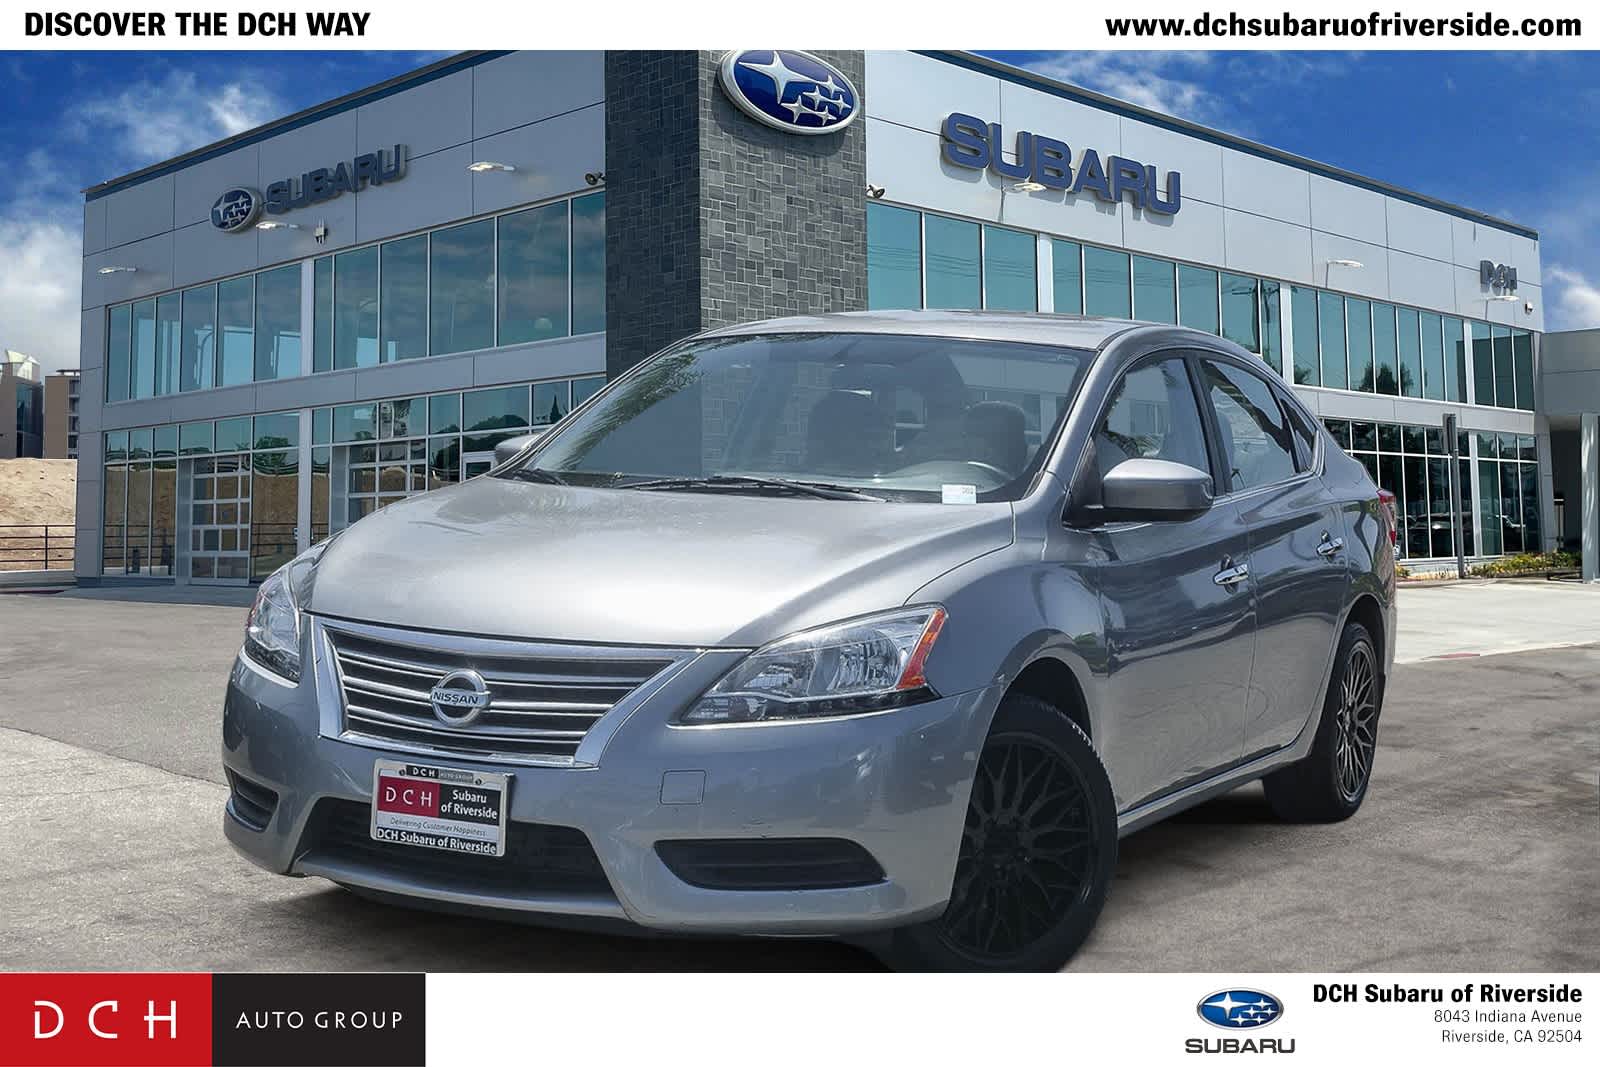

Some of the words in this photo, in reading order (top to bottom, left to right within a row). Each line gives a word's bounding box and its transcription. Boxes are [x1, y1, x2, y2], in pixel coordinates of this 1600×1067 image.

[940, 111, 1182, 216] SUBARU
[265, 143, 408, 215] SUBARU
[433, 691, 479, 704] NISSAN
[412, 767, 436, 777] DCH
[385, 787, 432, 807] DCH
[452, 789, 487, 803] Subaru
[440, 802, 452, 813] of
[453, 804, 498, 819] Riverside
[377, 828, 399, 840] DCH
[400, 831, 436, 846] Subaru
[437, 836, 449, 847] of
[450, 838, 497, 854] Riverside
